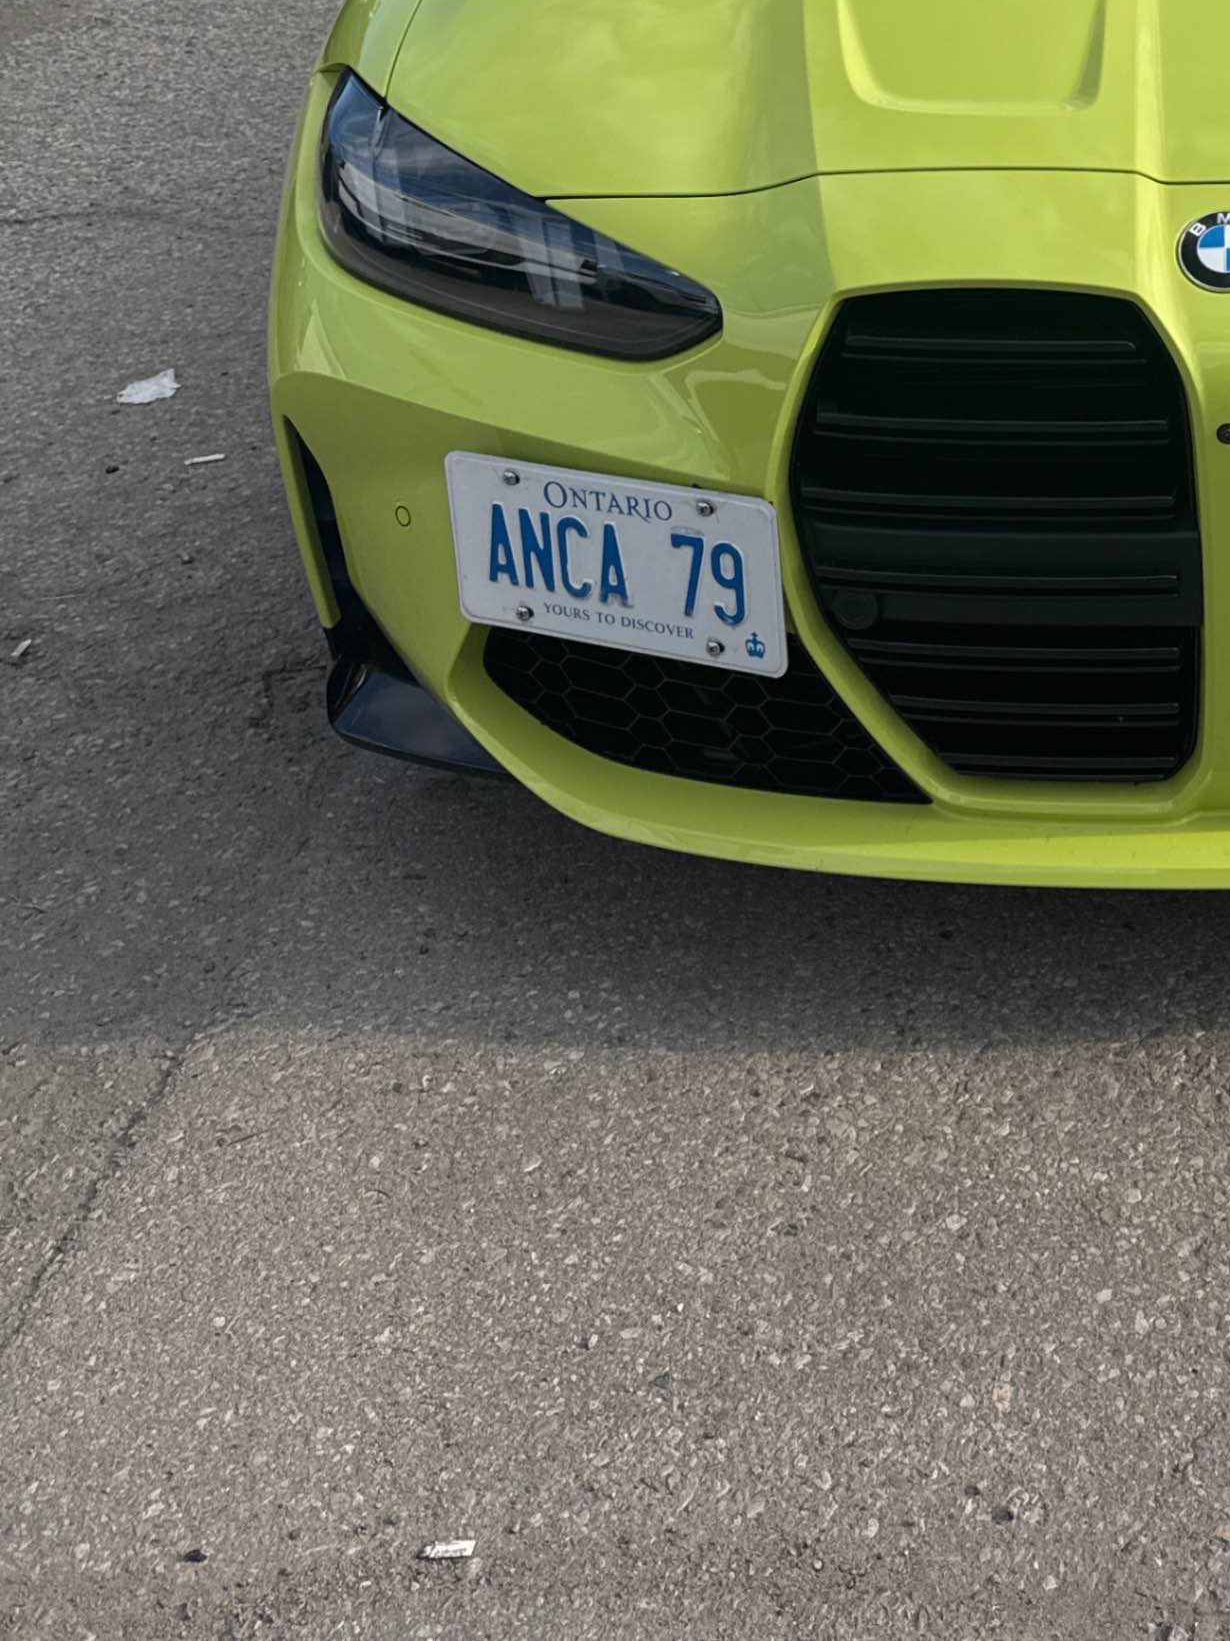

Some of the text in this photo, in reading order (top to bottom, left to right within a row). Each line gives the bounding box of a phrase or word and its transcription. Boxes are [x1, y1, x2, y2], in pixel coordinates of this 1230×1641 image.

[543, 481, 673, 524] ONTARIO
[489, 500, 747, 628] ANCA 79
[544, 602, 695, 639] YOURS TO DISCOVER
